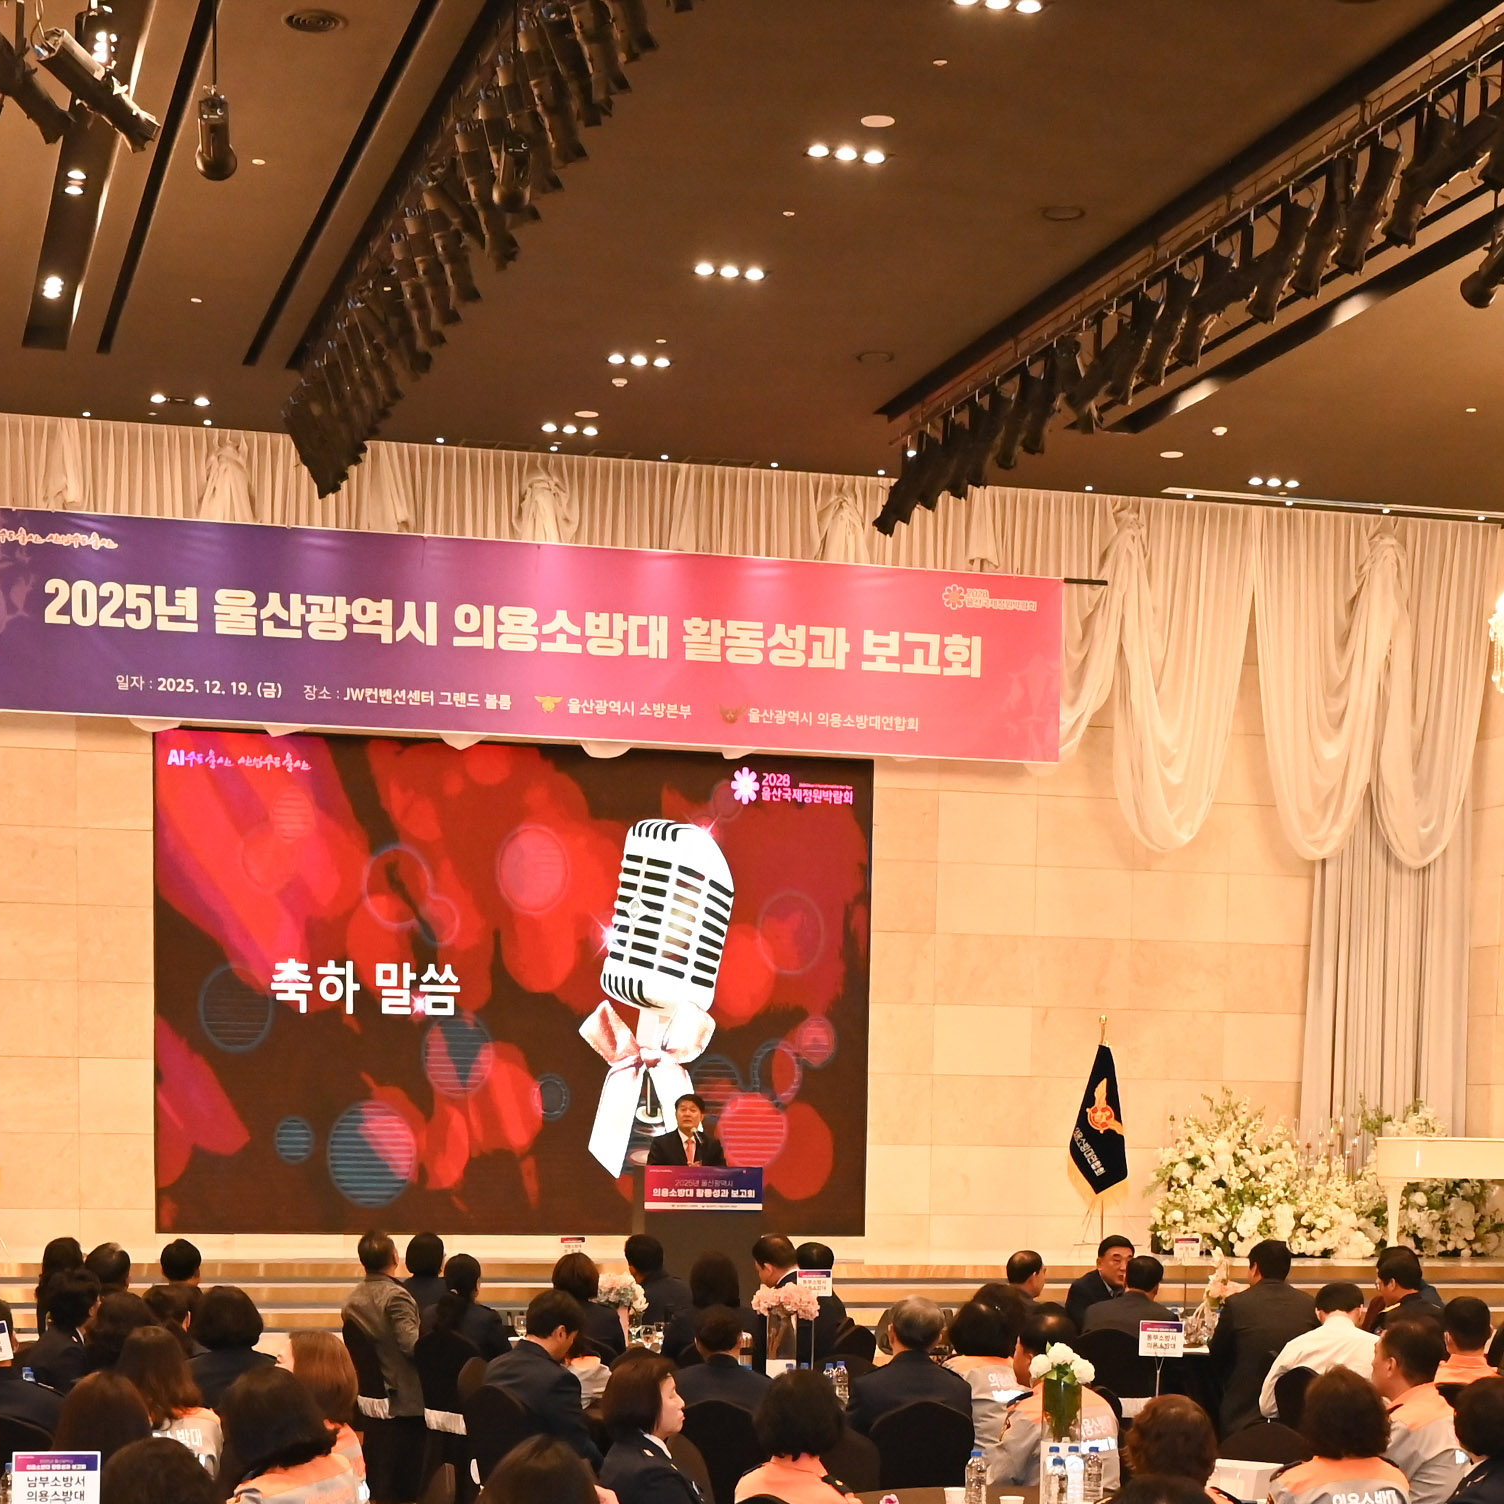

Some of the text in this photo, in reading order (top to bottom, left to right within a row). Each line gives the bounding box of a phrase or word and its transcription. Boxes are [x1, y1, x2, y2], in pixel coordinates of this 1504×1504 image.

[44, 578, 982, 678] 2025년 울산광역시 의용소방대 활동성과 보고회
[116, 674, 145, 691] 일자
[157, 676, 199, 694] 2025.
[203, 680, 224, 695] 12.
[230, 681, 252, 696] 19.
[257, 682, 282, 699] (금)
[303, 683, 333, 700] 장소
[343, 687, 435, 707] JW컨벤션센터
[439, 690, 480, 708] 그랜드
[568, 697, 692, 720] 울산광역시 소방본부
[748, 707, 919, 733] 울산광역시 의용소방대연합회
[761, 773, 790, 786] 2028
[761, 787, 853, 805] 울산국제정원박람회
[269, 957, 462, 1016] 축하 말씀
[652, 1187, 694, 1198] 의용소방대
[26, 1475, 86, 1488] 남부소방서
[26, 1490, 86, 1503] 의용소방대
